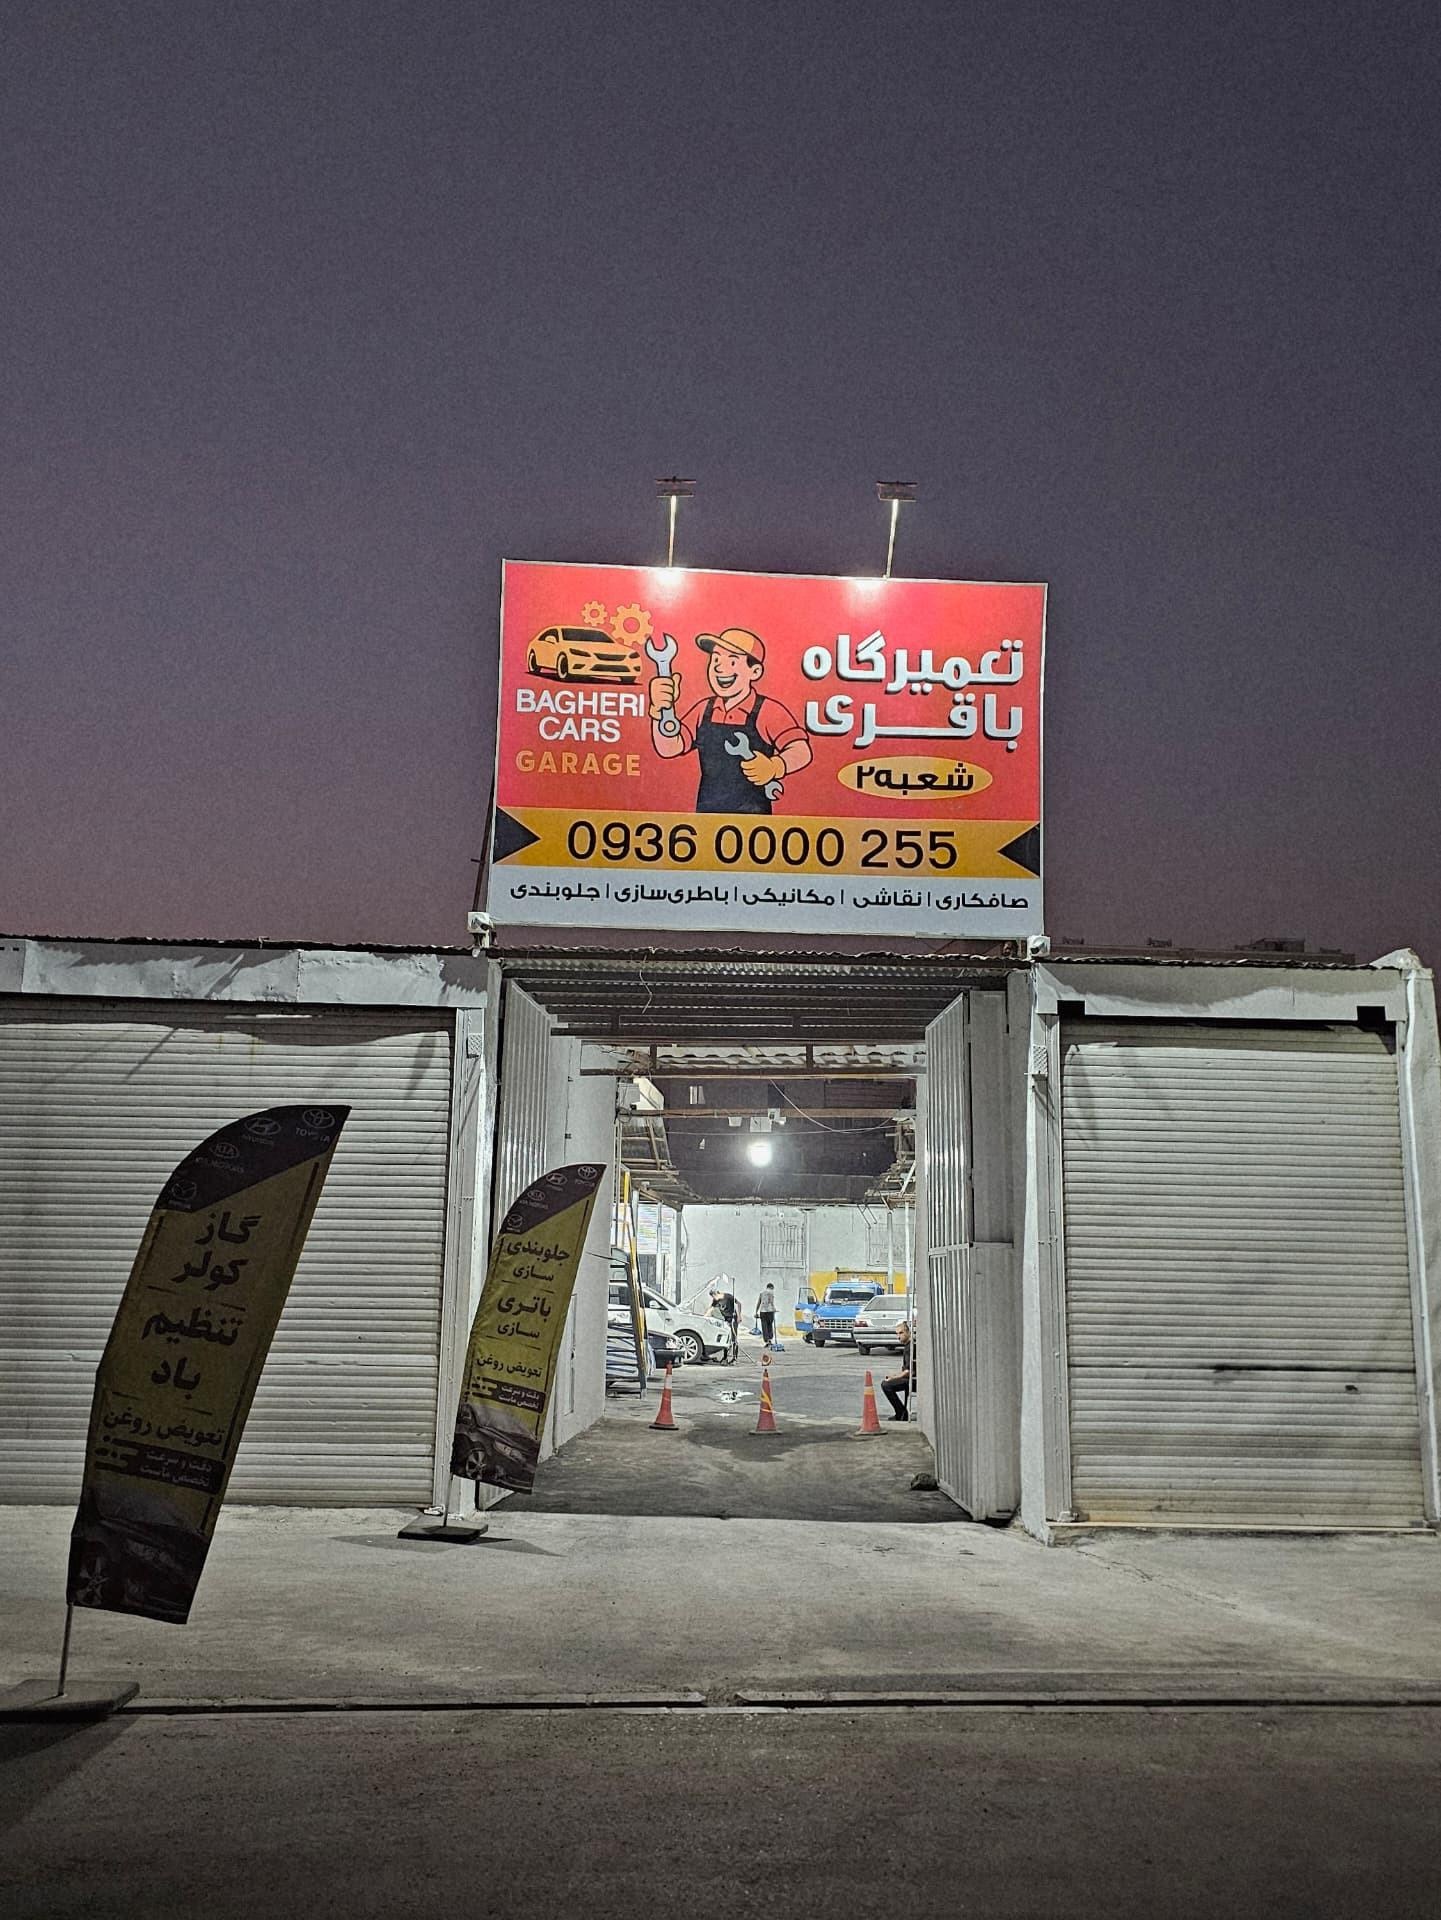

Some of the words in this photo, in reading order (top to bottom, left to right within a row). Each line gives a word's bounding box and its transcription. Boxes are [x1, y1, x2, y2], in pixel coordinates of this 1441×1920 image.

[801, 630, 1024, 695] تعمیرگاه
[515, 688, 645, 718] BAGHERI
[538, 715, 622, 743] CARS
[804, 692, 1023, 752] باقری
[515, 749, 641, 777] GARAGE
[567, 820, 698, 863] 0936
[714, 824, 845, 868] 0000
[860, 828, 958, 870] 255
[510, 881, 600, 901] جلوبندی
[742, 887, 836, 907] مکانیکی
[852, 887, 922, 908] نقاشی
[935, 891, 1029, 910] صافکاری
[194, 1211, 263, 1245] گاز
[507, 1240, 570, 1266] جلوبندی
[170, 1250, 250, 1291] کولر
[512, 1265, 554, 1282] سازی
[497, 1296, 551, 1323] باتری
[141, 1306, 244, 1346] تنظیم
[497, 1321, 540, 1339] سازی
[476, 1353, 504, 1371] روغن
[506, 1361, 543, 1378] تعویض
[151, 1356, 201, 1400] باد
[103, 1406, 152, 1436] روغن
[156, 1418, 226, 1447] تعویض
